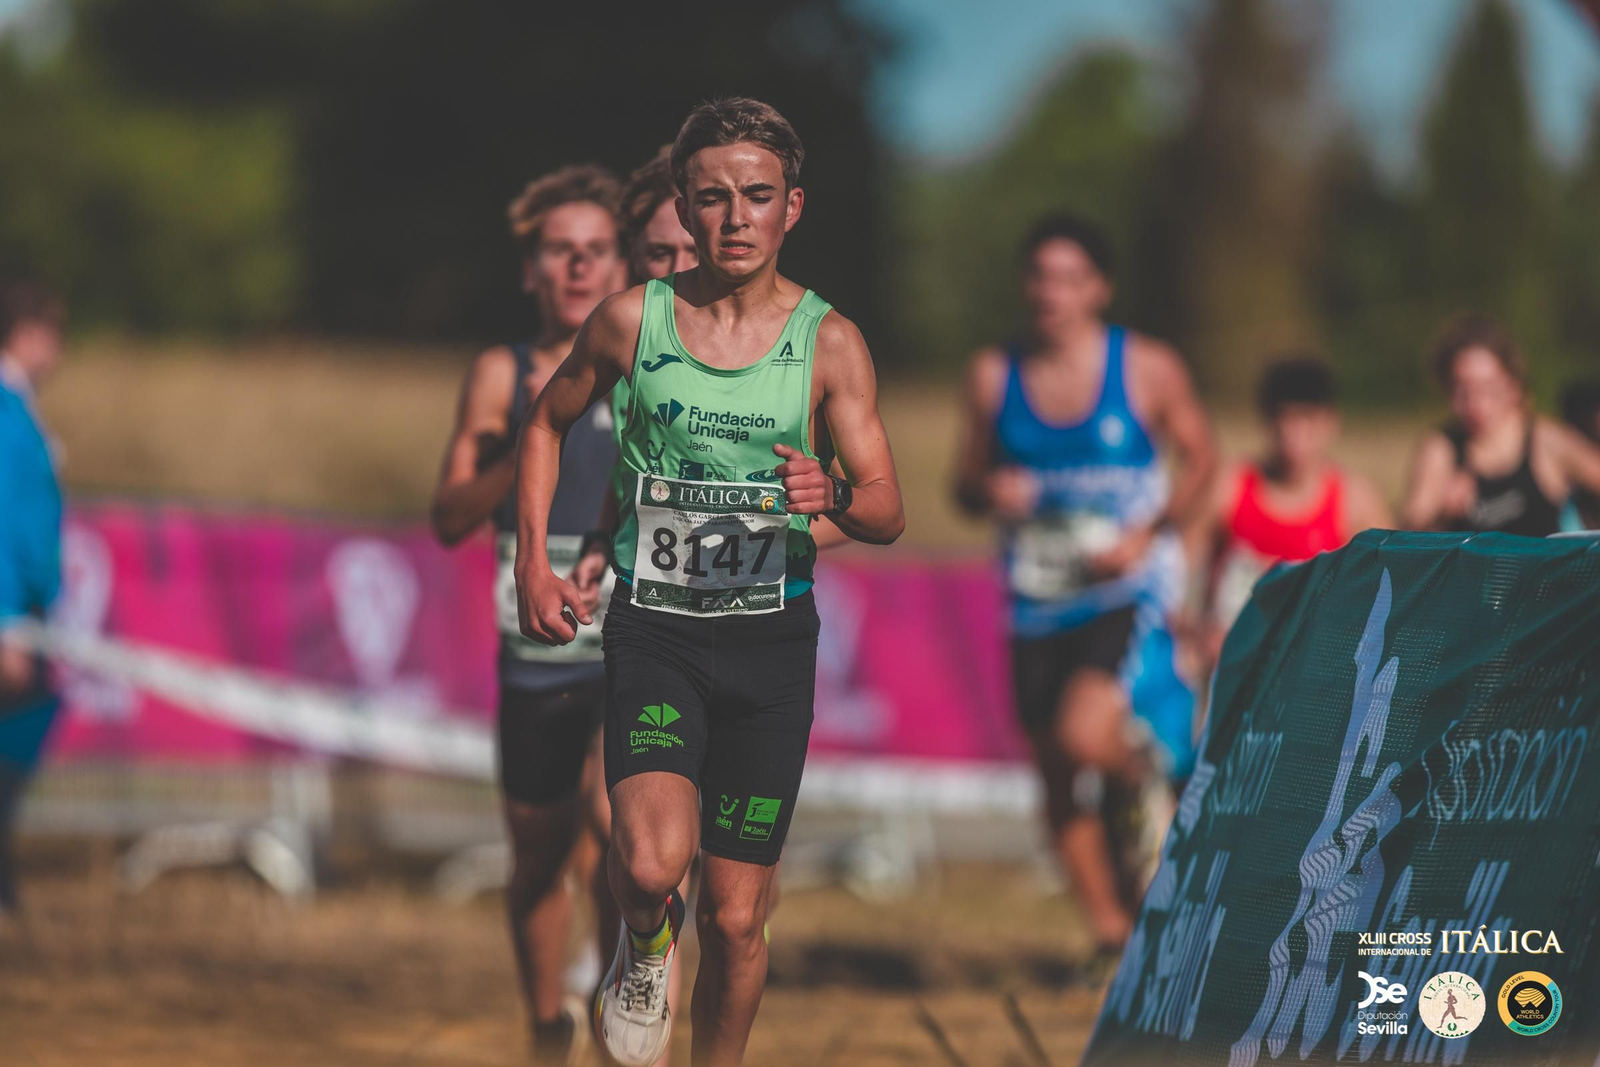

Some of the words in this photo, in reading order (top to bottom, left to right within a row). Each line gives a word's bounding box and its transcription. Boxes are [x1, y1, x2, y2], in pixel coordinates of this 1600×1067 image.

[689, 405, 776, 429] Fundación
[687, 420, 750, 445] Unicaja
[686, 439, 713, 453] Jaén
[679, 486, 751, 505] ITÁLICA
[673, 510, 697, 519] CARLOS
[651, 527, 776, 577] 8147
[630, 729, 684, 748] Fundación
[630, 736, 672, 748] Unicaja
[630, 746, 649, 755] Jaén
